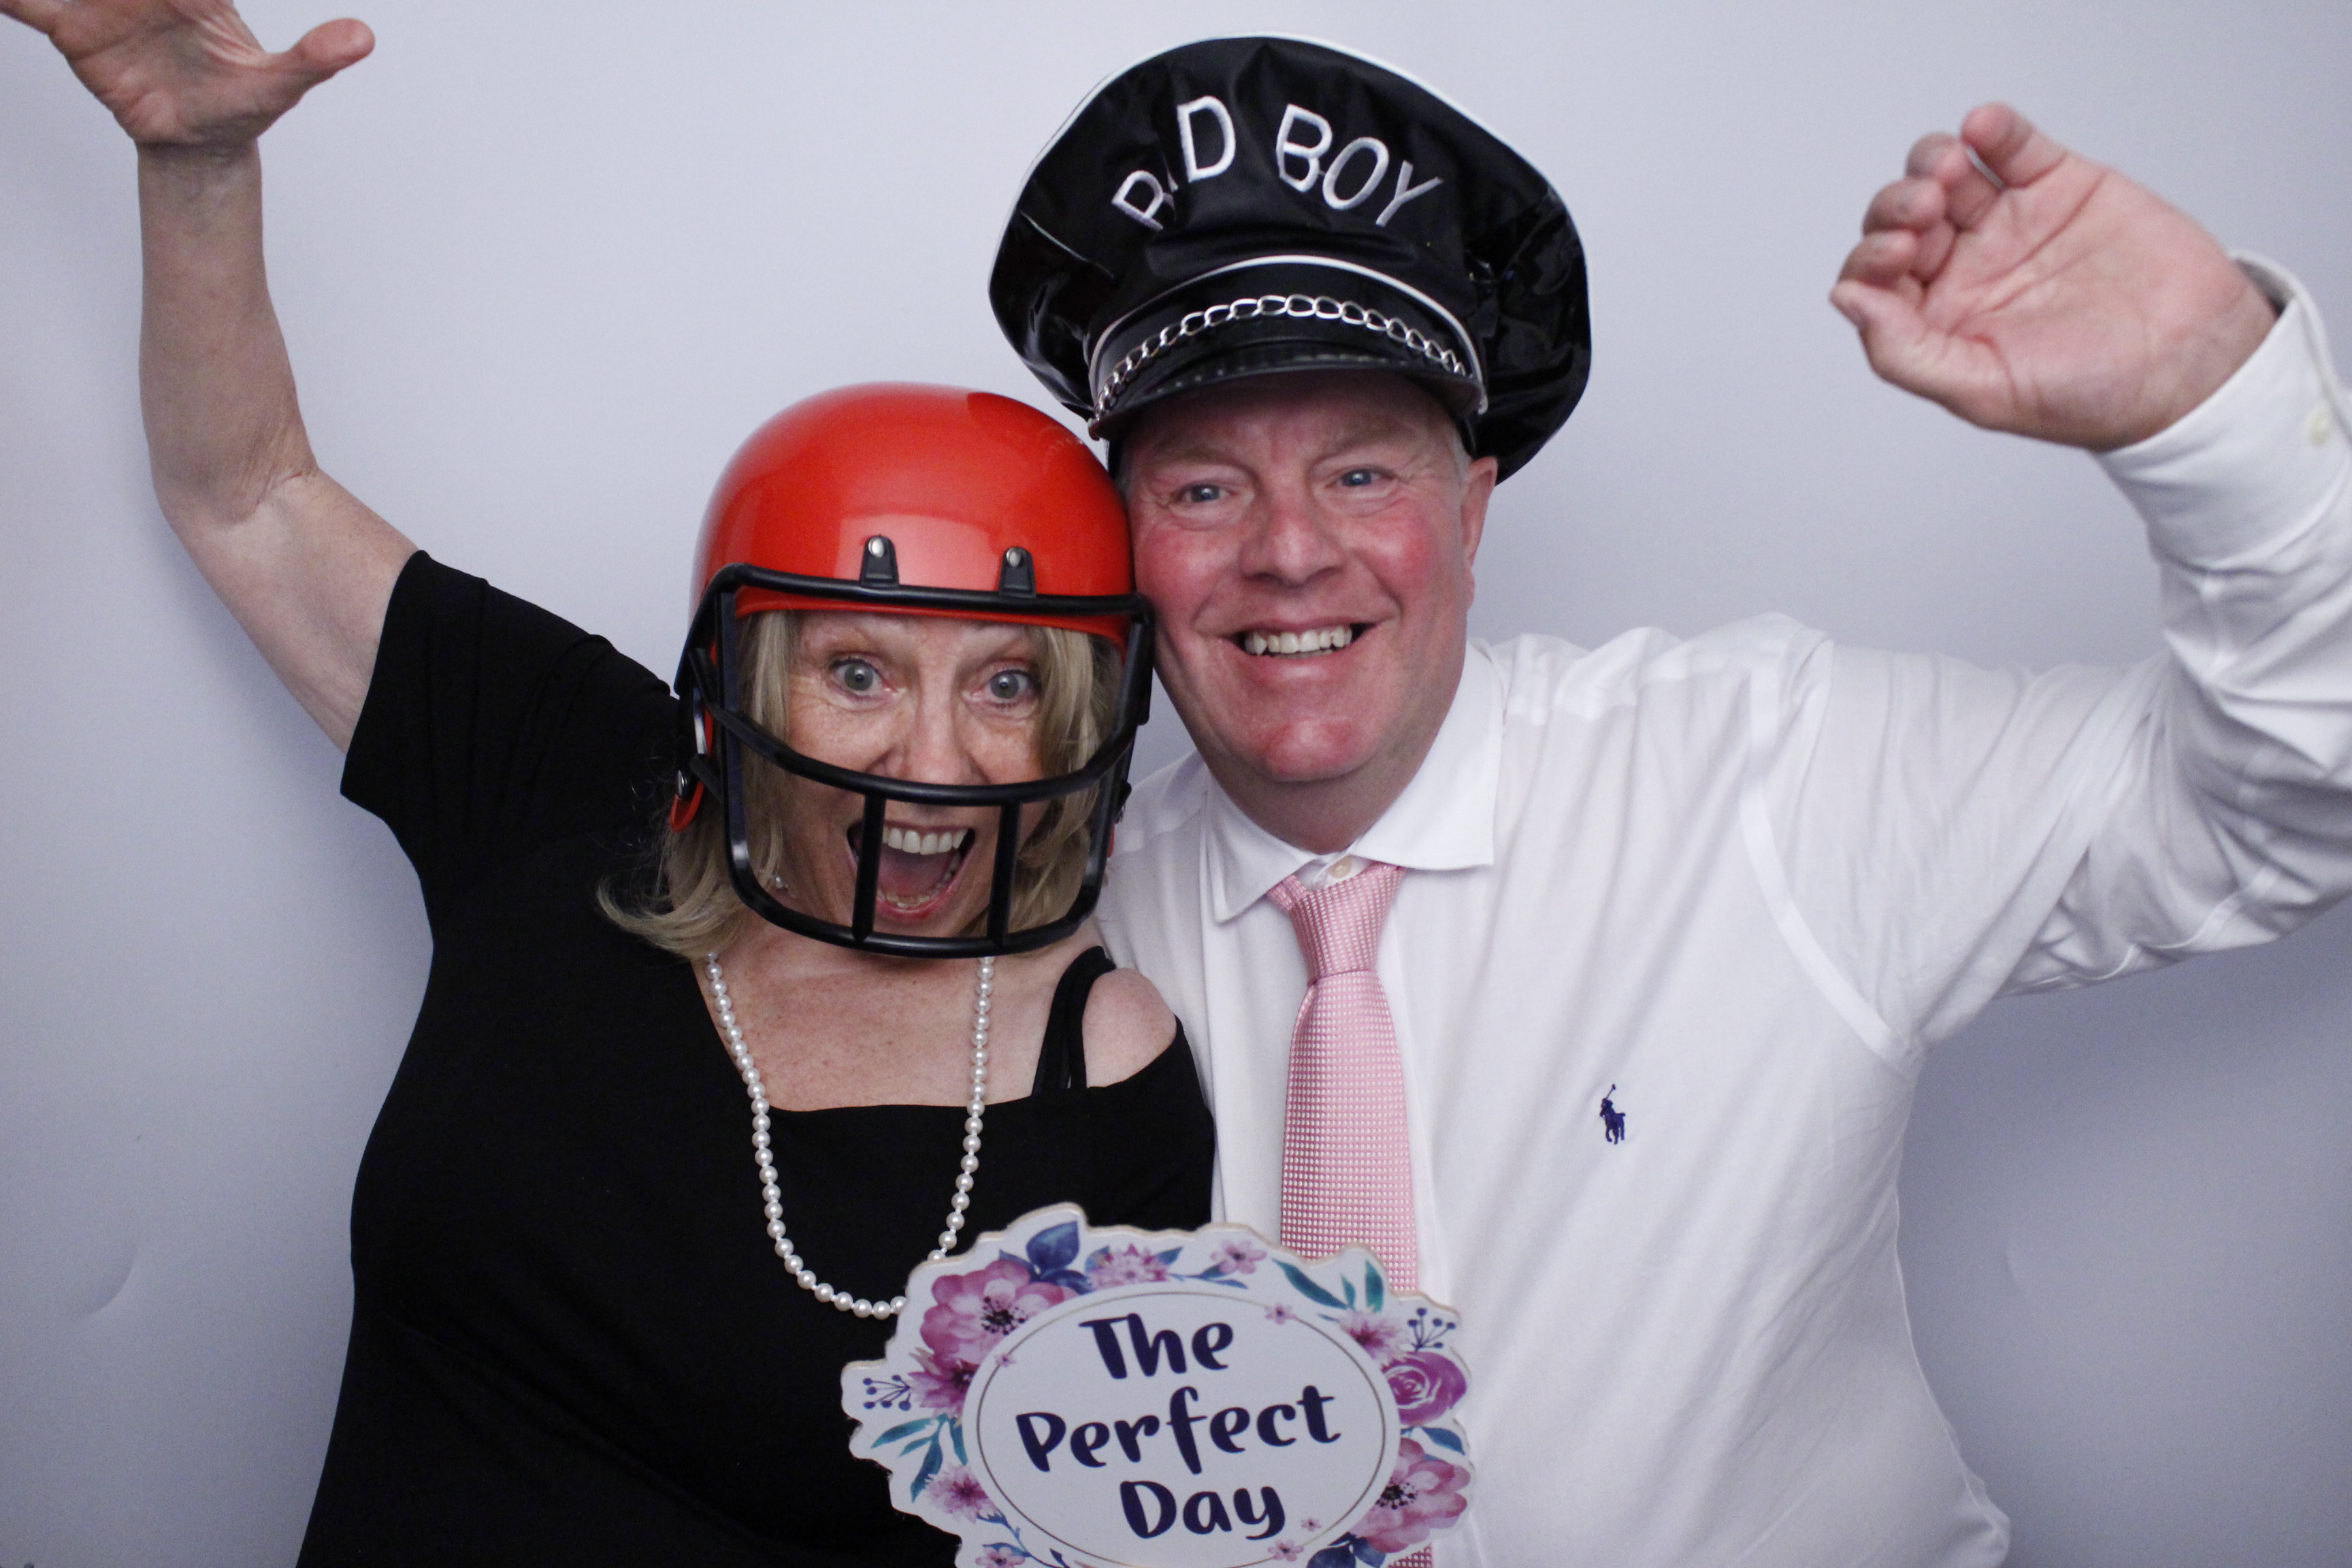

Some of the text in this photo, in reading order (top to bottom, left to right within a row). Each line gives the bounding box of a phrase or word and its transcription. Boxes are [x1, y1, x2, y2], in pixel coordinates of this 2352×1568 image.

[1111, 95, 1443, 230] BD BOY
[1079, 1313, 1233, 1379] The
[1015, 1385, 1341, 1475] Perfect
[1120, 1480, 1286, 1541] Day
